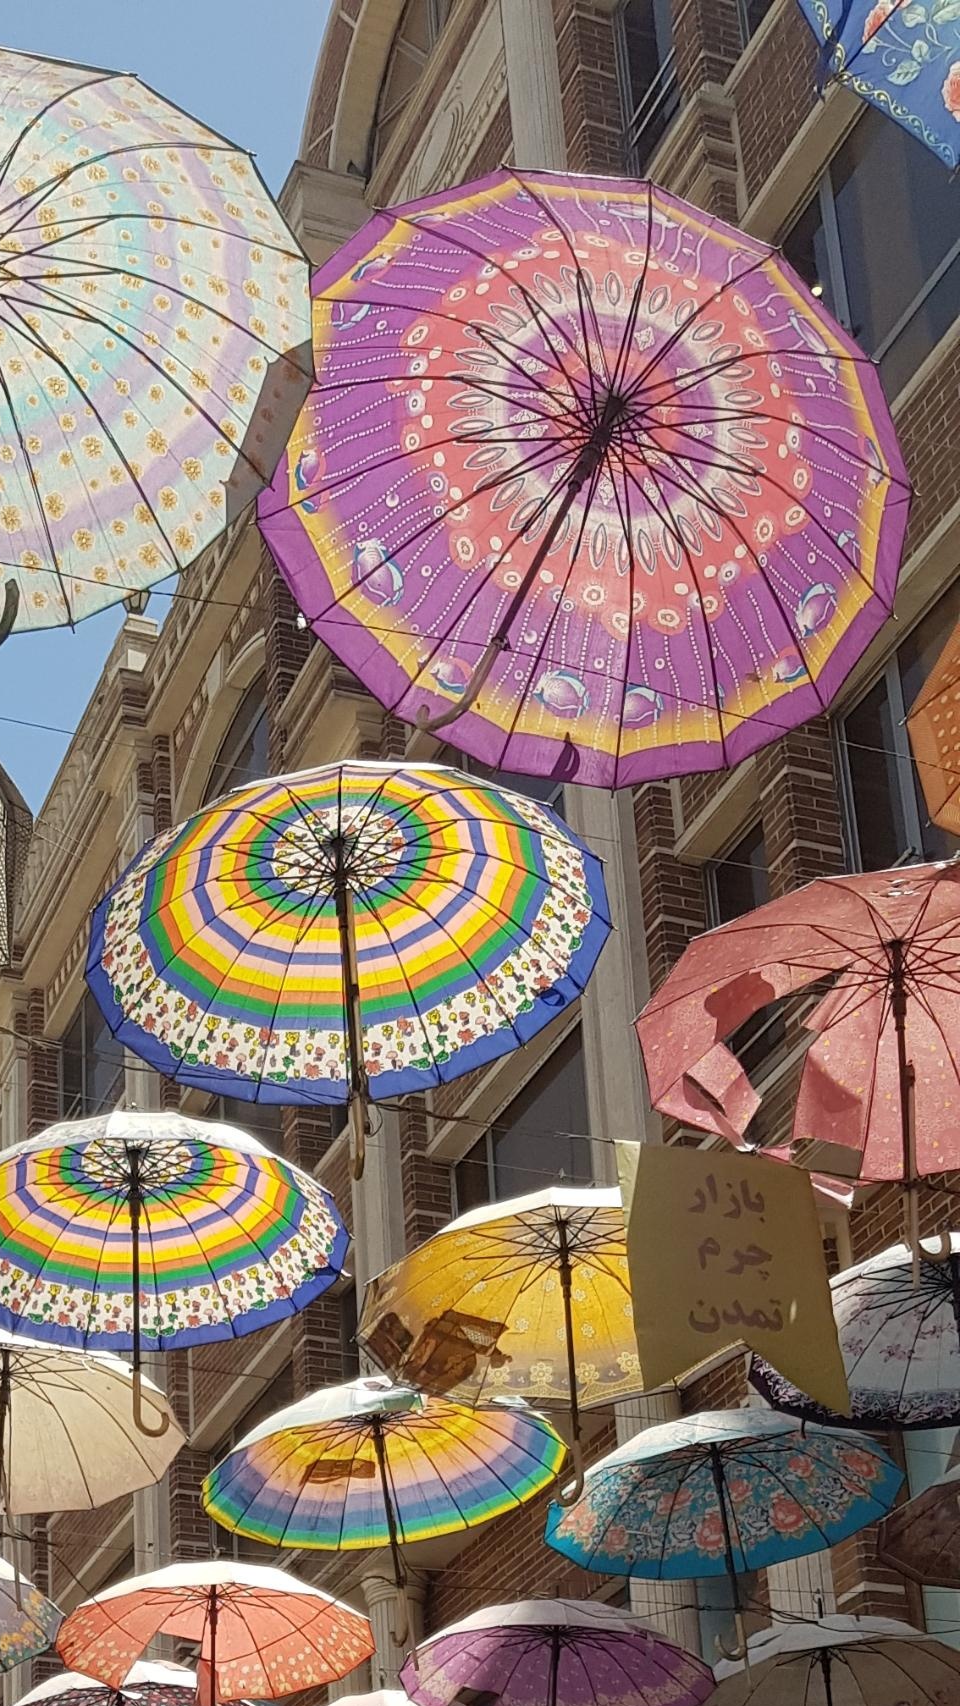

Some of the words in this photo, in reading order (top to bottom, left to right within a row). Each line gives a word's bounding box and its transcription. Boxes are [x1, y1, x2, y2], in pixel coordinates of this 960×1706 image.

[687, 1173, 766, 1223] بازار
[696, 1236, 773, 1280] چرم
[687, 1297, 784, 1333] تمدن
